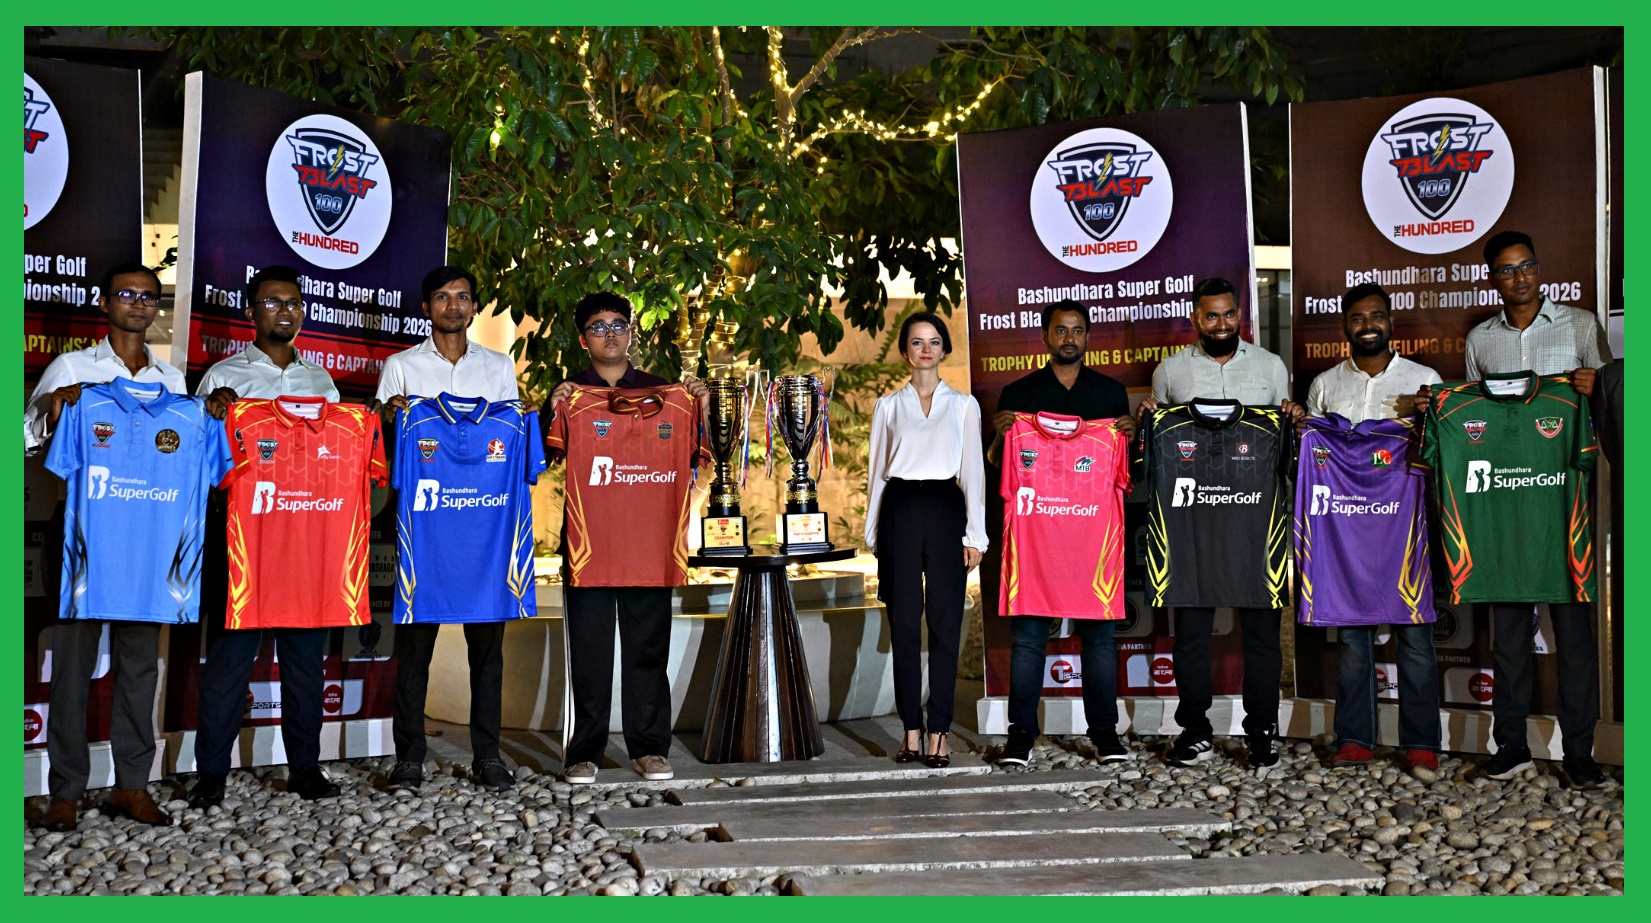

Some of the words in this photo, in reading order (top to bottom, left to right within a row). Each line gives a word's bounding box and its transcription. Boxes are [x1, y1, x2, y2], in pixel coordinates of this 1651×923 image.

[1381, 123, 1494, 160] FROST
[286, 135, 379, 179] FROST
[1389, 150, 1494, 178] BLAST
[1047, 151, 1153, 186] FROST
[292, 163, 377, 199] BLAST
[1056, 176, 1153, 202] BLAST
[1417, 179, 1451, 198] 100
[315, 193, 343, 214] 100
[1083, 203, 1115, 220] 100
[1402, 219, 1475, 237] HUNDRED
[299, 232, 359, 255] HUNDRED
[1062, 245, 1070, 257] THE
[1070, 240, 1138, 257] HUNDRED
[24, 253, 52, 274] per
[56, 254, 86, 277] Golf
[1346, 265, 1446, 288] Bashundhara
[1452, 263, 1490, 283] Supe
[24, 278, 86, 307] ionship
[338, 281, 375, 304] Super
[378, 288, 402, 308] Golf
[1018, 280, 1114, 305] Bashundhara
[1118, 279, 1161, 299] Super
[1165, 274, 1194, 294] Golf
[1305, 295, 1342, 315] Frost
[1389, 291, 1415, 311] 100
[1420, 287, 1505, 310] Champion
[1539, 281, 1581, 303] 2026
[205, 284, 242, 309] Frost
[310, 302, 400, 335] Championship
[402, 316, 433, 337] 2026
[980, 312, 1016, 331] Frost
[1020, 311, 1042, 328] Bla
[202, 335, 254, 356] TROPH
[1305, 342, 1351, 359] TROPH
[1389, 338, 1439, 356] EILING
[327, 352, 335, 369] &
[981, 354, 1034, 372] TROPHY
[1113, 349, 1121, 364] &
[614, 471, 678, 486] SuperGolf
[1493, 472, 1567, 491] SuperGolf
[109, 484, 180, 502] SuperGolf
[278, 489, 313, 497] Bashundhara
[441, 493, 509, 511] SuperGolf
[1197, 492, 1262, 507] SuperGolf
[1332, 494, 1367, 502] Bashundhara
[276, 498, 345, 514] SuperGolf
[1035, 502, 1100, 518] SuperGolf
[1331, 501, 1401, 517] SuperGolf
[251, 701, 282, 709] PORTS
